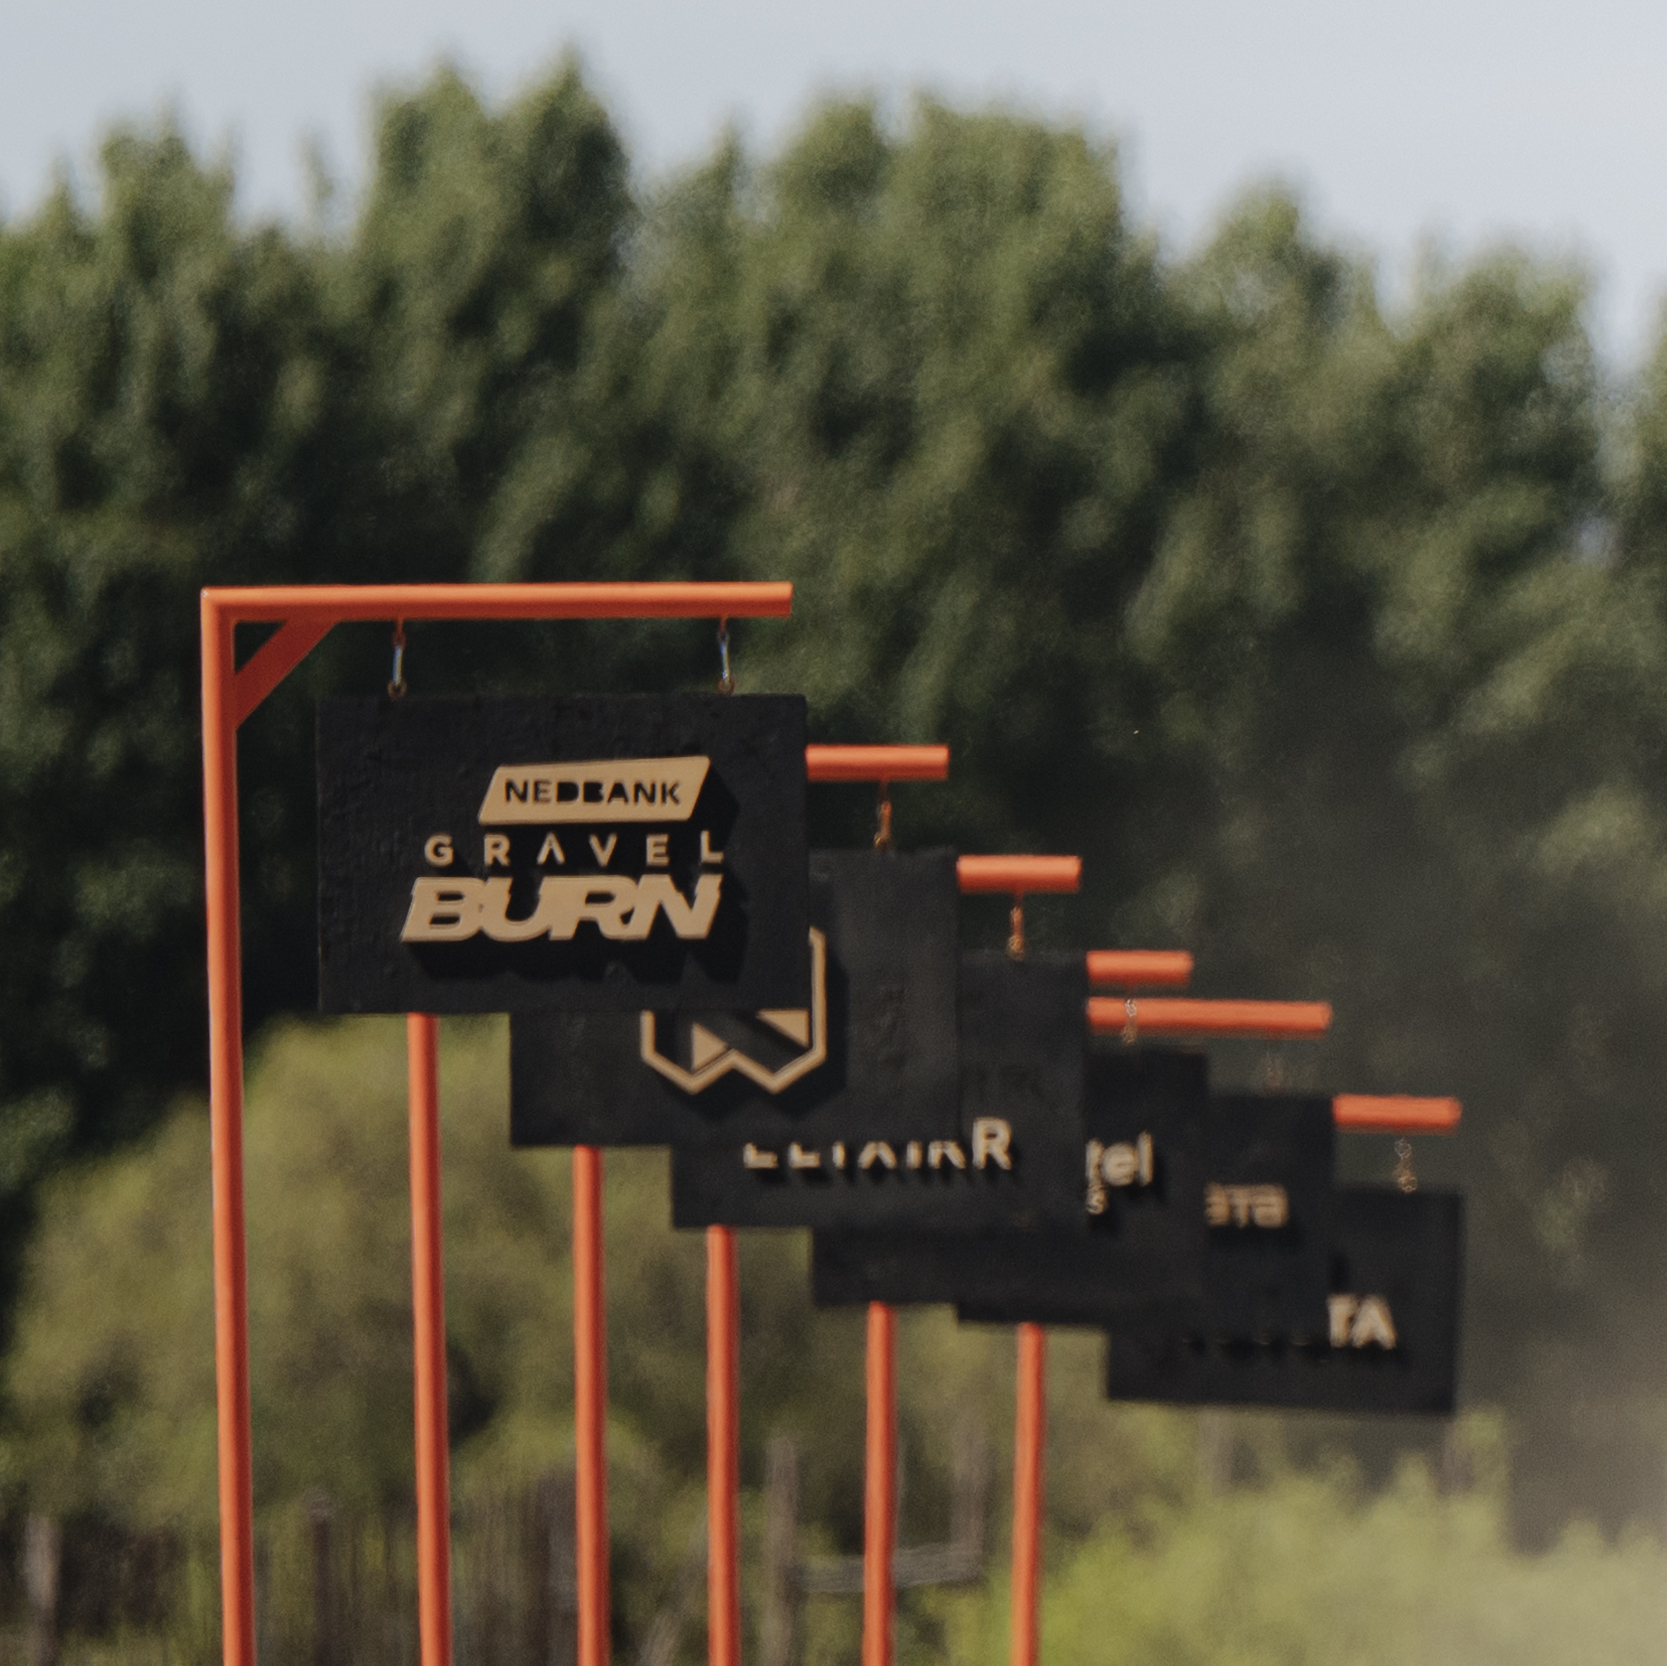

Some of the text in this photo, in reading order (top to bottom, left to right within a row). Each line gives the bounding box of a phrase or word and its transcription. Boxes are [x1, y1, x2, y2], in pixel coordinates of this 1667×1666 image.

[504, 779, 681, 805] NEDBANK
[424, 830, 724, 867] GRAVEL
[401, 874, 724, 943] BURN
